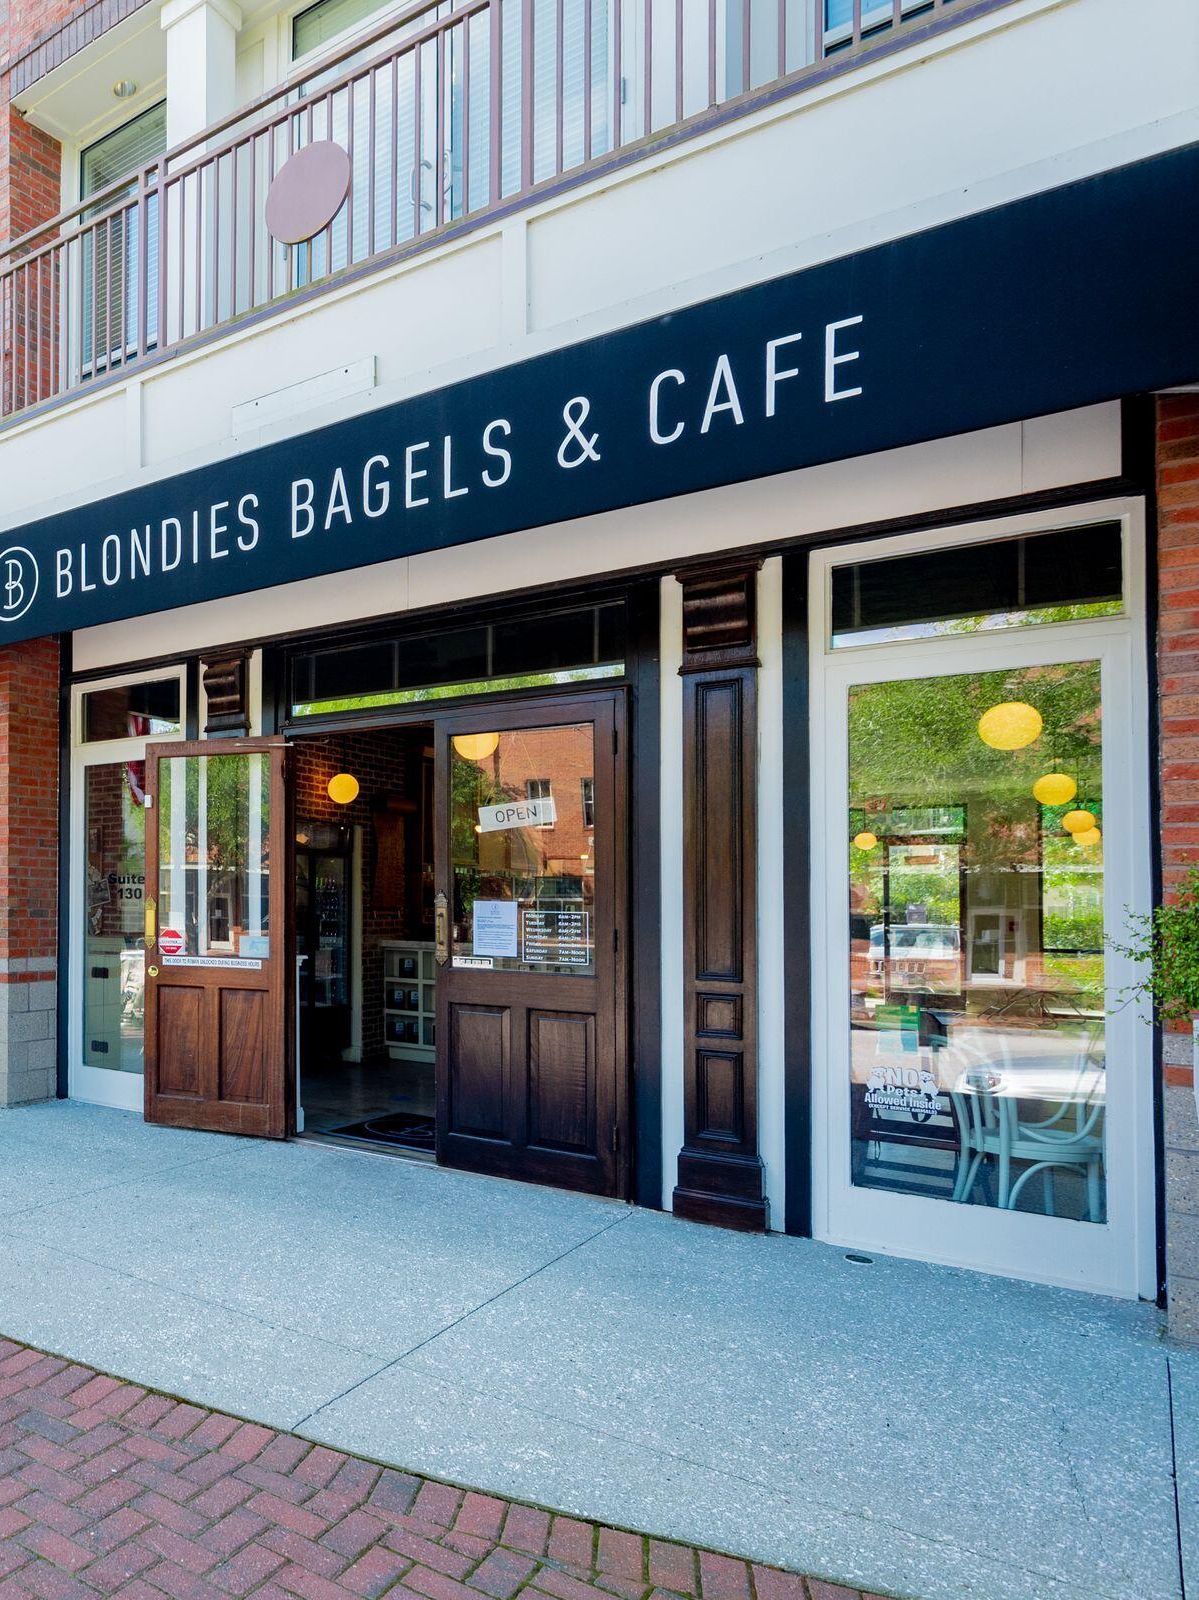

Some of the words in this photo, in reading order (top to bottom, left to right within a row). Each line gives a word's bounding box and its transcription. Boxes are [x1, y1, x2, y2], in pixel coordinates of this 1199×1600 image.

[56, 493, 259, 598] BLONDIES
[291, 419, 512, 539] BAGELS
[557, 396, 601, 469] &
[649, 315, 863, 445] CAFE
[496, 805, 537, 823] OPEN
[108, 873, 146, 885] Suite
[117, 888, 142, 900] 130
[886, 1067, 920, 1088] NO
[886, 1085, 918, 1097] Pets
[864, 1092, 907, 1107] Allowed
[910, 1098, 942, 1110] Inside
